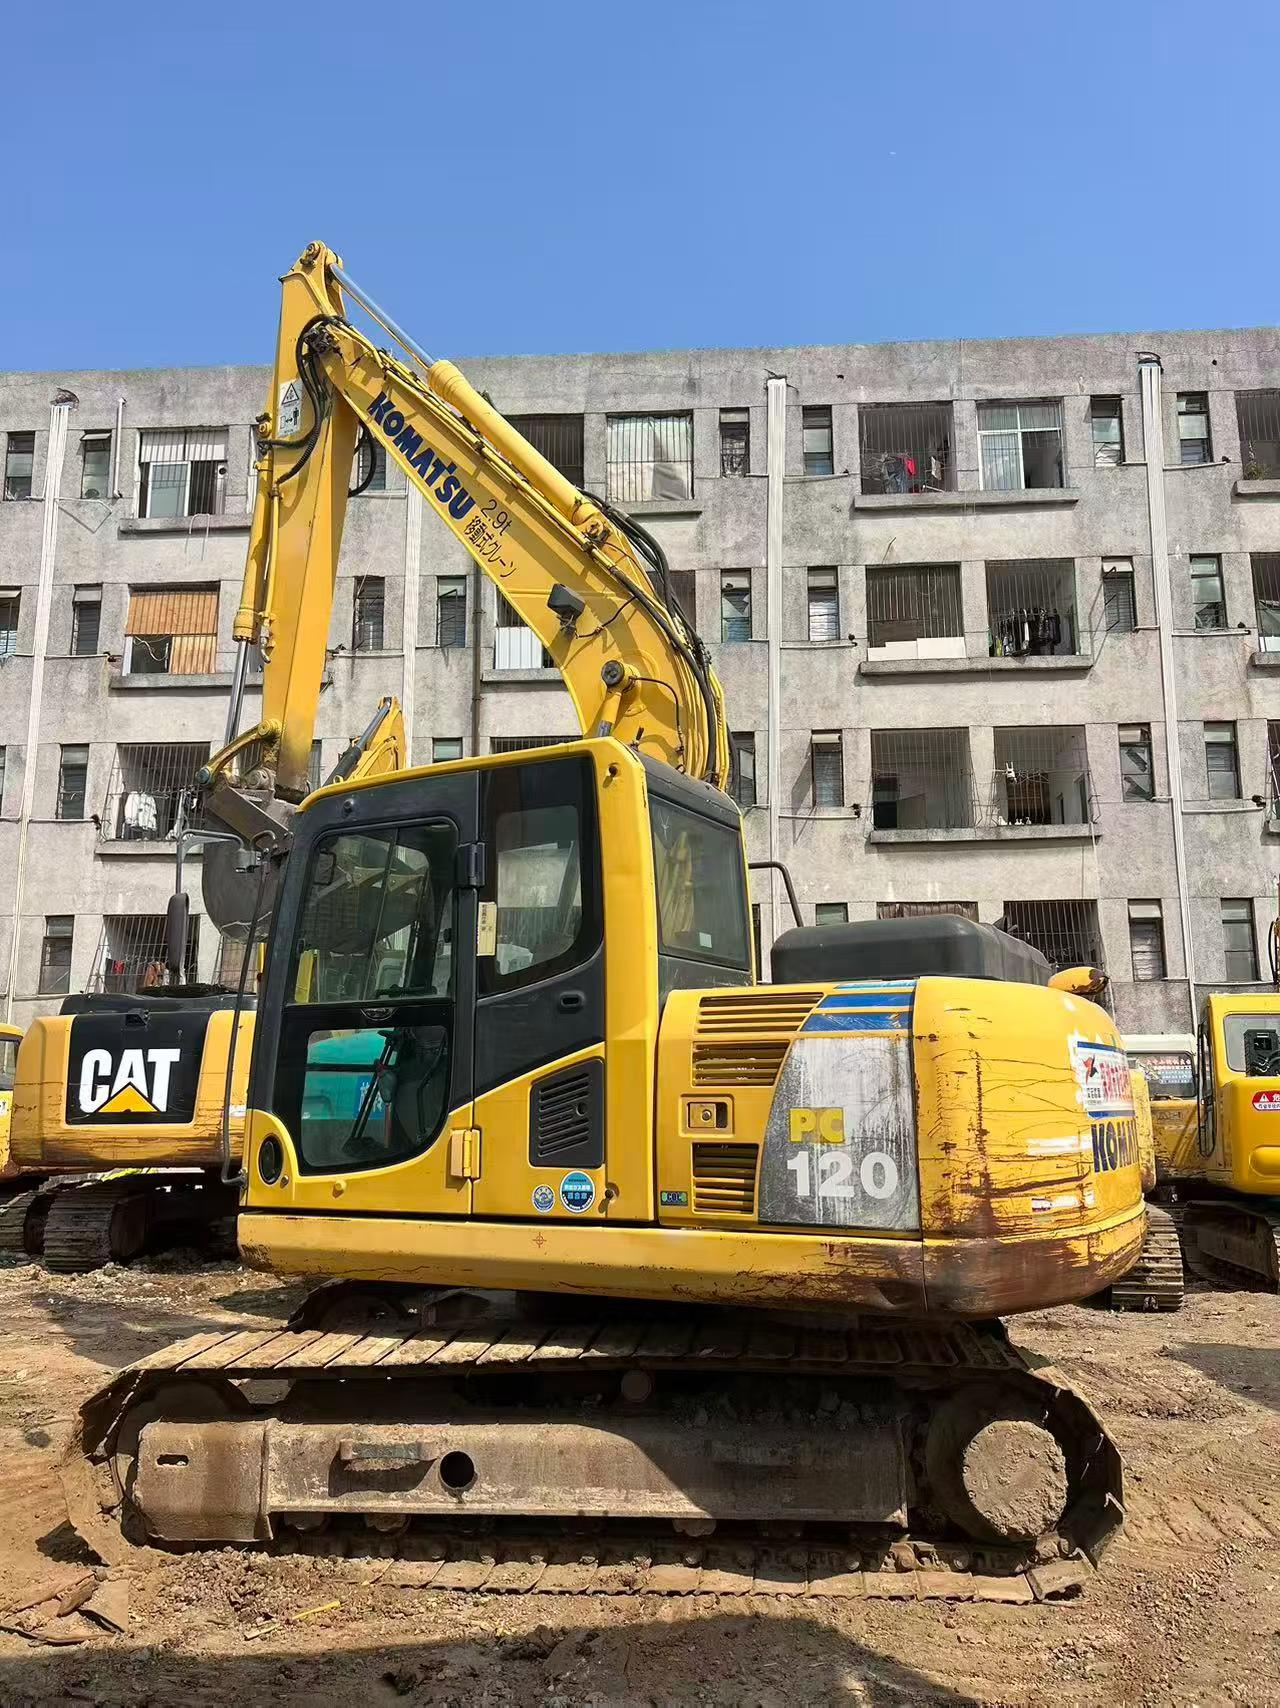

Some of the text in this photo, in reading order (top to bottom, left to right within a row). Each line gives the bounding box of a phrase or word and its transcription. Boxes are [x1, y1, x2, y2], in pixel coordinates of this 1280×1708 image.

[367, 391, 476, 519] KOMATSU
[481, 499, 512, 536] 2.9t
[464, 515, 516, 577] 移動式クレーン
[79, 1049, 181, 1113] CAT
[790, 1108, 843, 1142] PC
[787, 1151, 898, 1199] 120
